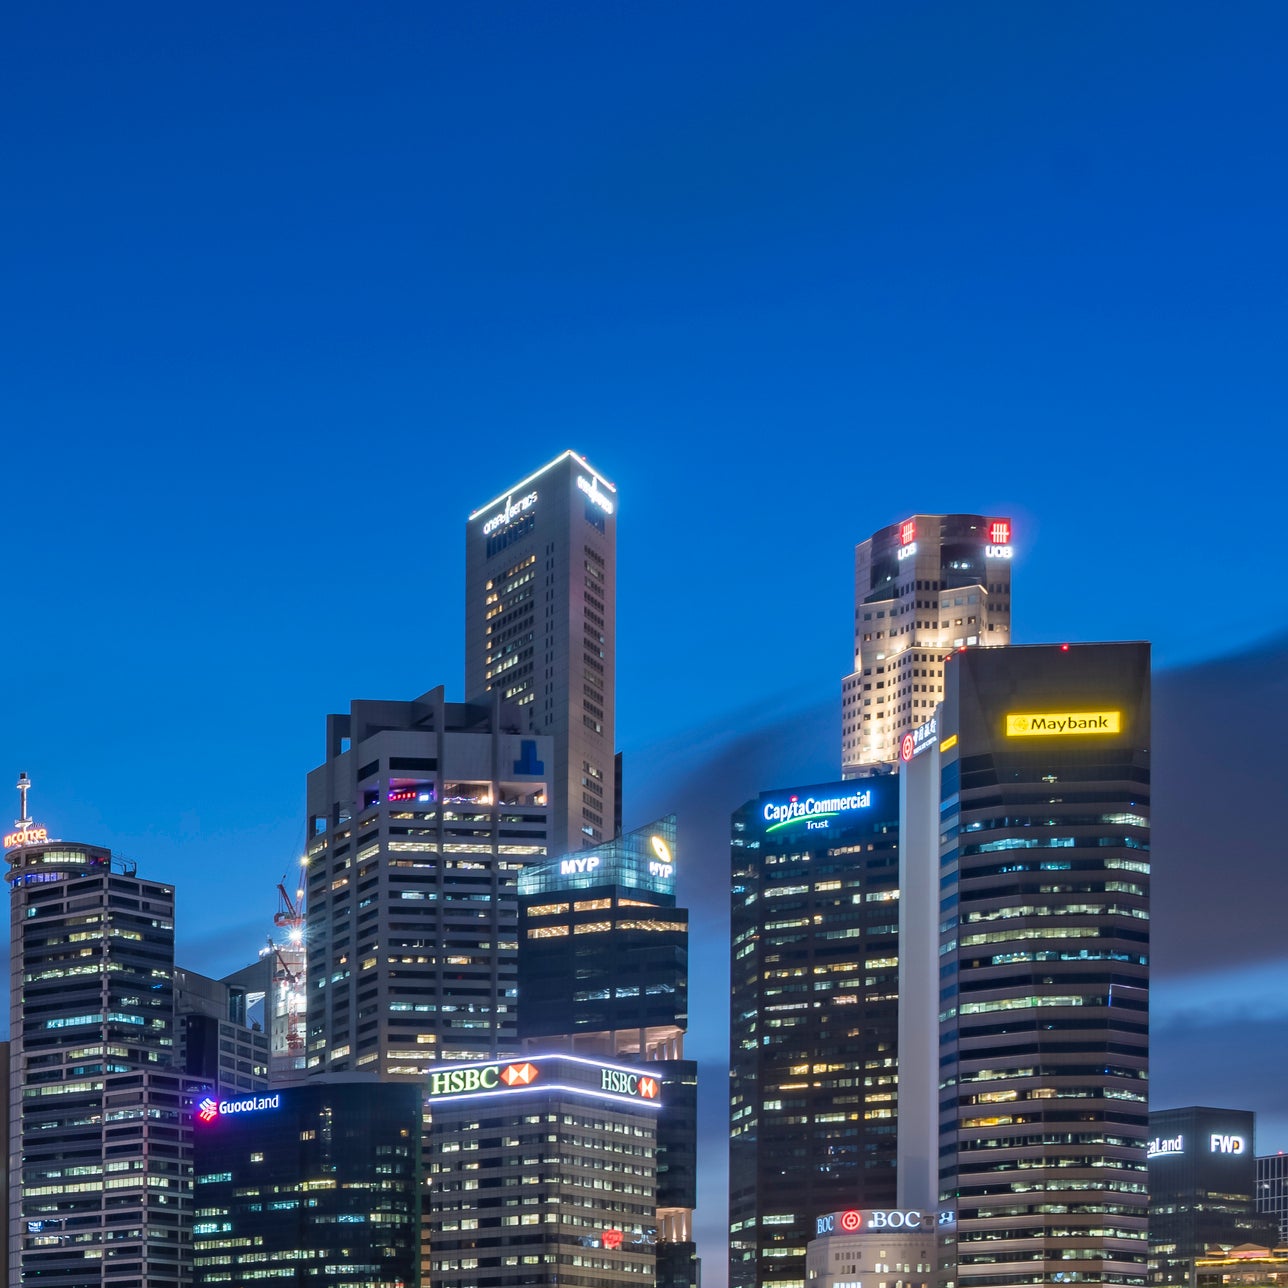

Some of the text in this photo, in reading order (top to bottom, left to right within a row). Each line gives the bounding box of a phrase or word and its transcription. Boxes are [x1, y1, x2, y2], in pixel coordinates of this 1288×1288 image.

[897, 542, 917, 560] UOB
[985, 545, 1012, 558] UOB
[1030, 715, 1108, 732] Maybank
[763, 790, 871, 822] CapitaCommercial
[806, 820, 829, 830] Trust
[560, 857, 600, 875] MYP
[431, 1066, 499, 1095] HSBC
[601, 1068, 638, 1096] HSBC
[1147, 1134, 1183, 1155] aLand
[1210, 1134, 1243, 1155] FWD
[817, 1215, 834, 1234] BOC
[871, 1211, 921, 1228] BOC
